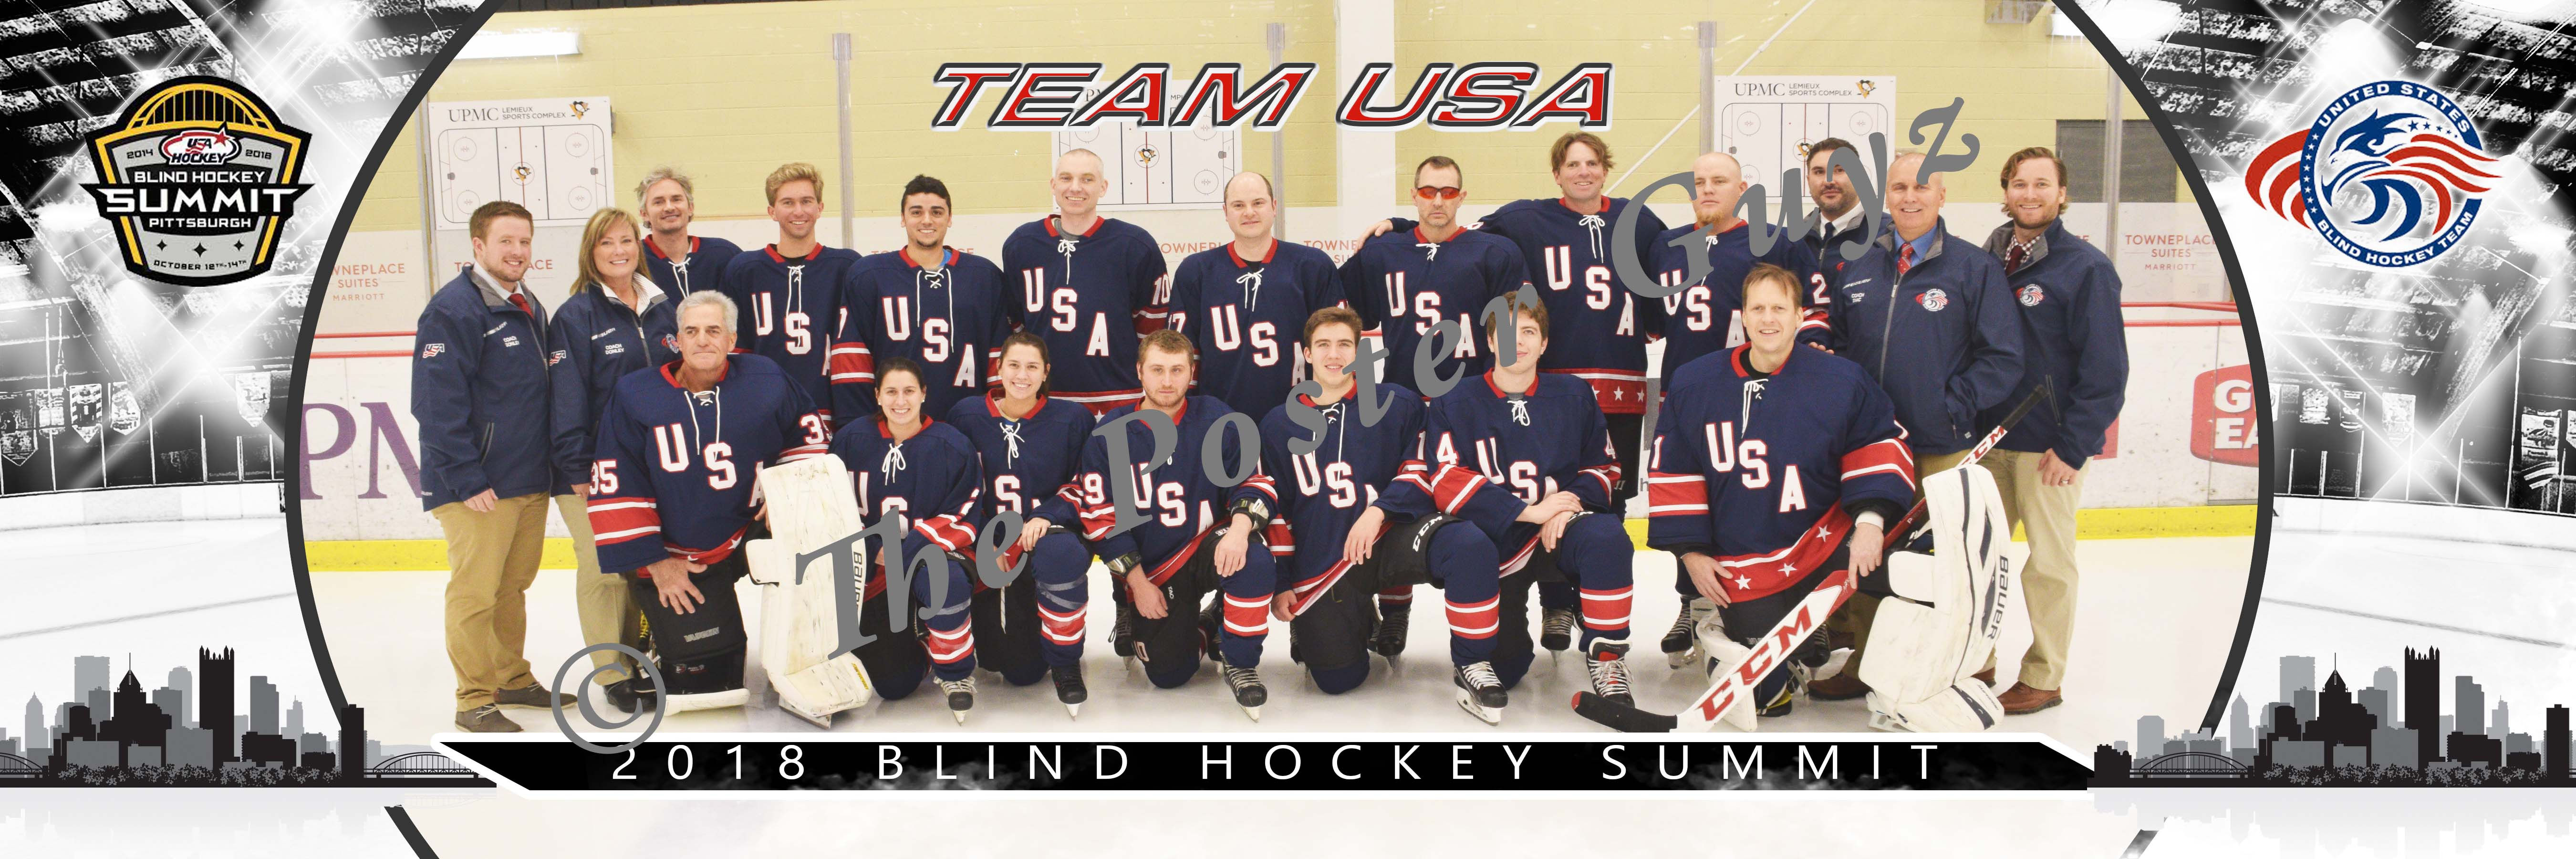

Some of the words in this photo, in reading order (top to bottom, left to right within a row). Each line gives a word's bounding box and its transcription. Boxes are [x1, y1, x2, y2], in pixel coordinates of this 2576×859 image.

[1734, 83, 1785, 96] UPMC
[448, 107, 499, 122] UPMC
[2125, 234, 2216, 245] TOWNEPLAC
[2151, 248, 2192, 258] SUITES
[332, 263, 405, 275] WNEPLACE
[338, 278, 379, 288] SUITES
[332, 293, 385, 302] MARRIOTT
[1152, 273, 1171, 306] 10
[1544, 245, 1634, 336] USA
[1022, 267, 1110, 357] USA
[1385, 271, 1476, 359] USA
[882, 296, 976, 388] USA
[1705, 421, 1807, 513] USA
[1080, 471, 1106, 505] 9
[1413, 515, 1443, 552] CCM
[1698, 604, 1812, 722] CCM
